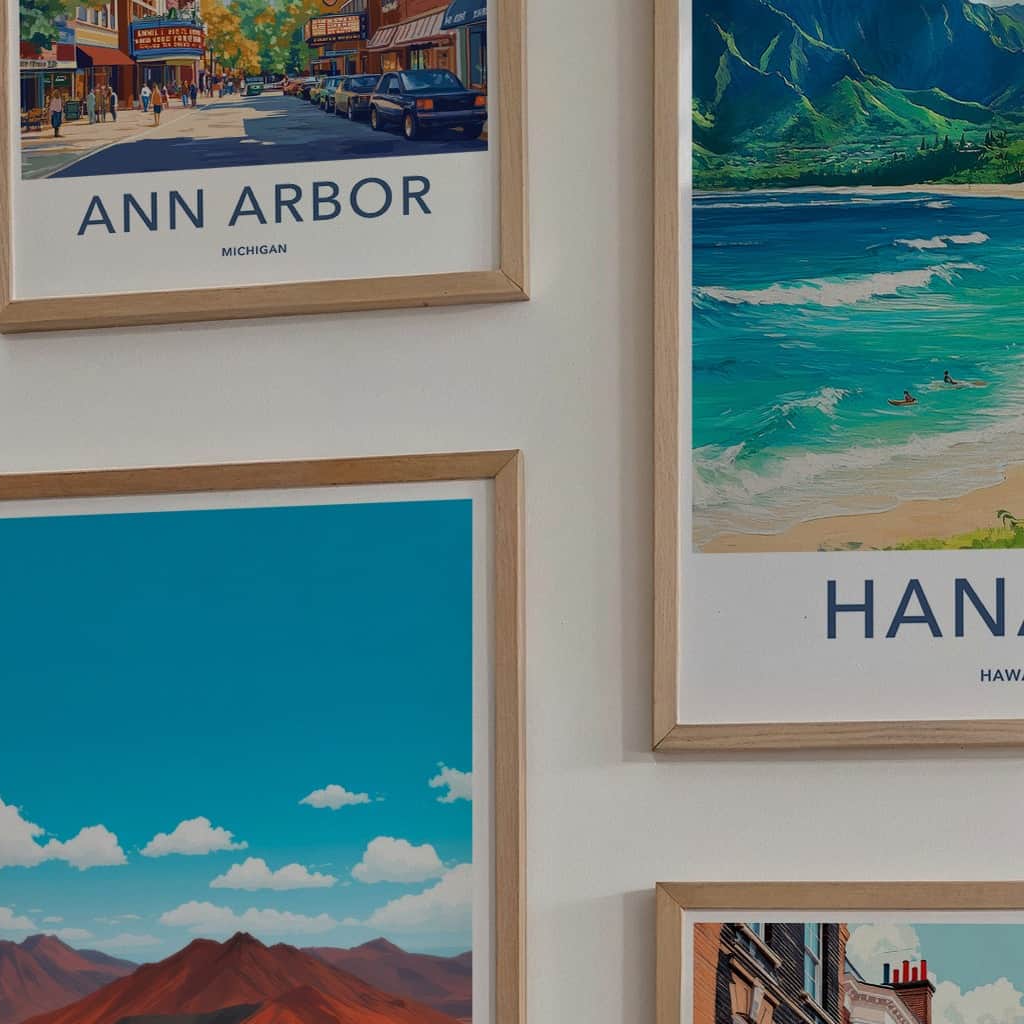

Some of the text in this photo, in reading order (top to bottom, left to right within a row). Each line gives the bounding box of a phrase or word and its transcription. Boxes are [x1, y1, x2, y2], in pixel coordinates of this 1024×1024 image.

[77, 175, 432, 236] ANN ARBOR
[221, 243, 288, 257] MICHIGAN
[826, 577, 1024, 639] HAN
[980, 669, 1024, 682] HAW
